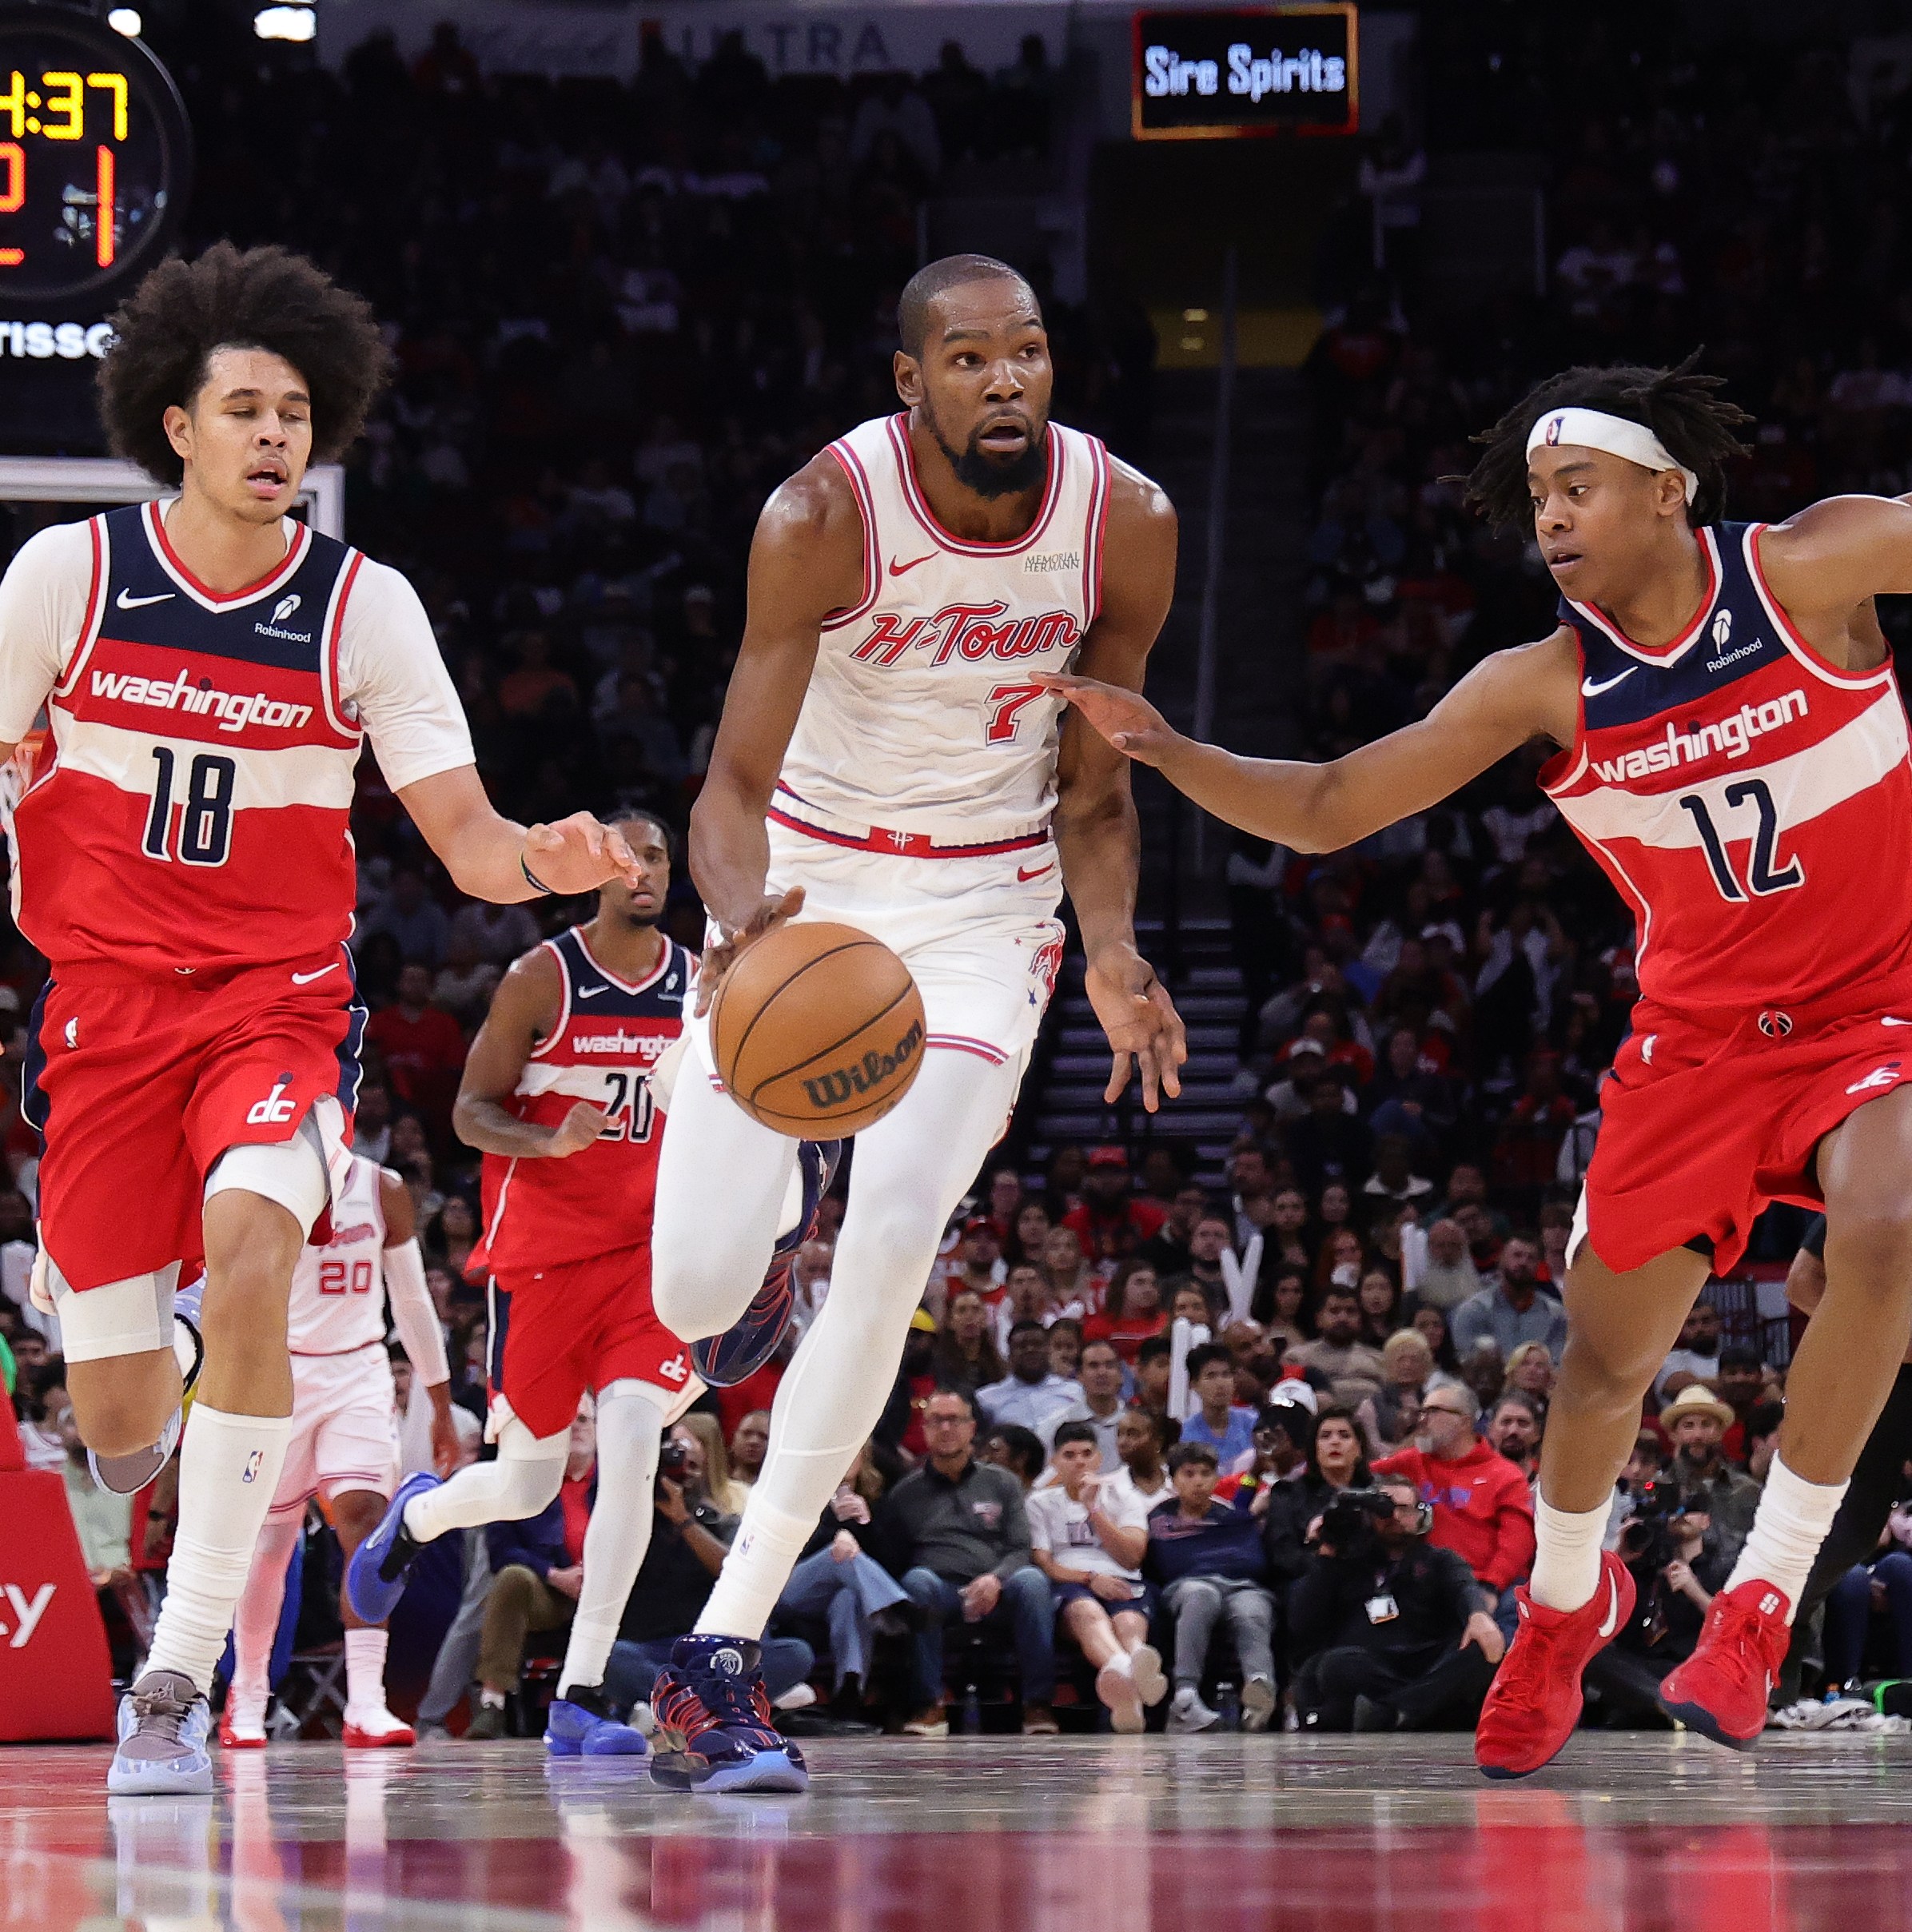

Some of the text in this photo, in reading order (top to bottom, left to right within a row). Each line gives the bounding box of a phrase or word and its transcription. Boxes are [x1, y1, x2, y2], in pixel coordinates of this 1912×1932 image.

[1145, 43, 1345, 103] Sire Spirits
[1024, 559, 1079, 572] HERMANN
[1026, 552, 1079, 564] MEMORIAL
[254, 623, 312, 643] Robinhood
[849, 600, 1081, 667] H-Town
[1706, 638, 1763, 673] Robinhood
[91, 668, 313, 732] washington
[984, 683, 1050, 747] 7
[1591, 689, 1809, 783] washington
[141, 744, 237, 867] 18
[1679, 778, 1806, 902] 12
[802, 1018, 922, 1109] Wilson
[597, 1071, 656, 1143] 20
[320, 1260, 372, 1294] 20
